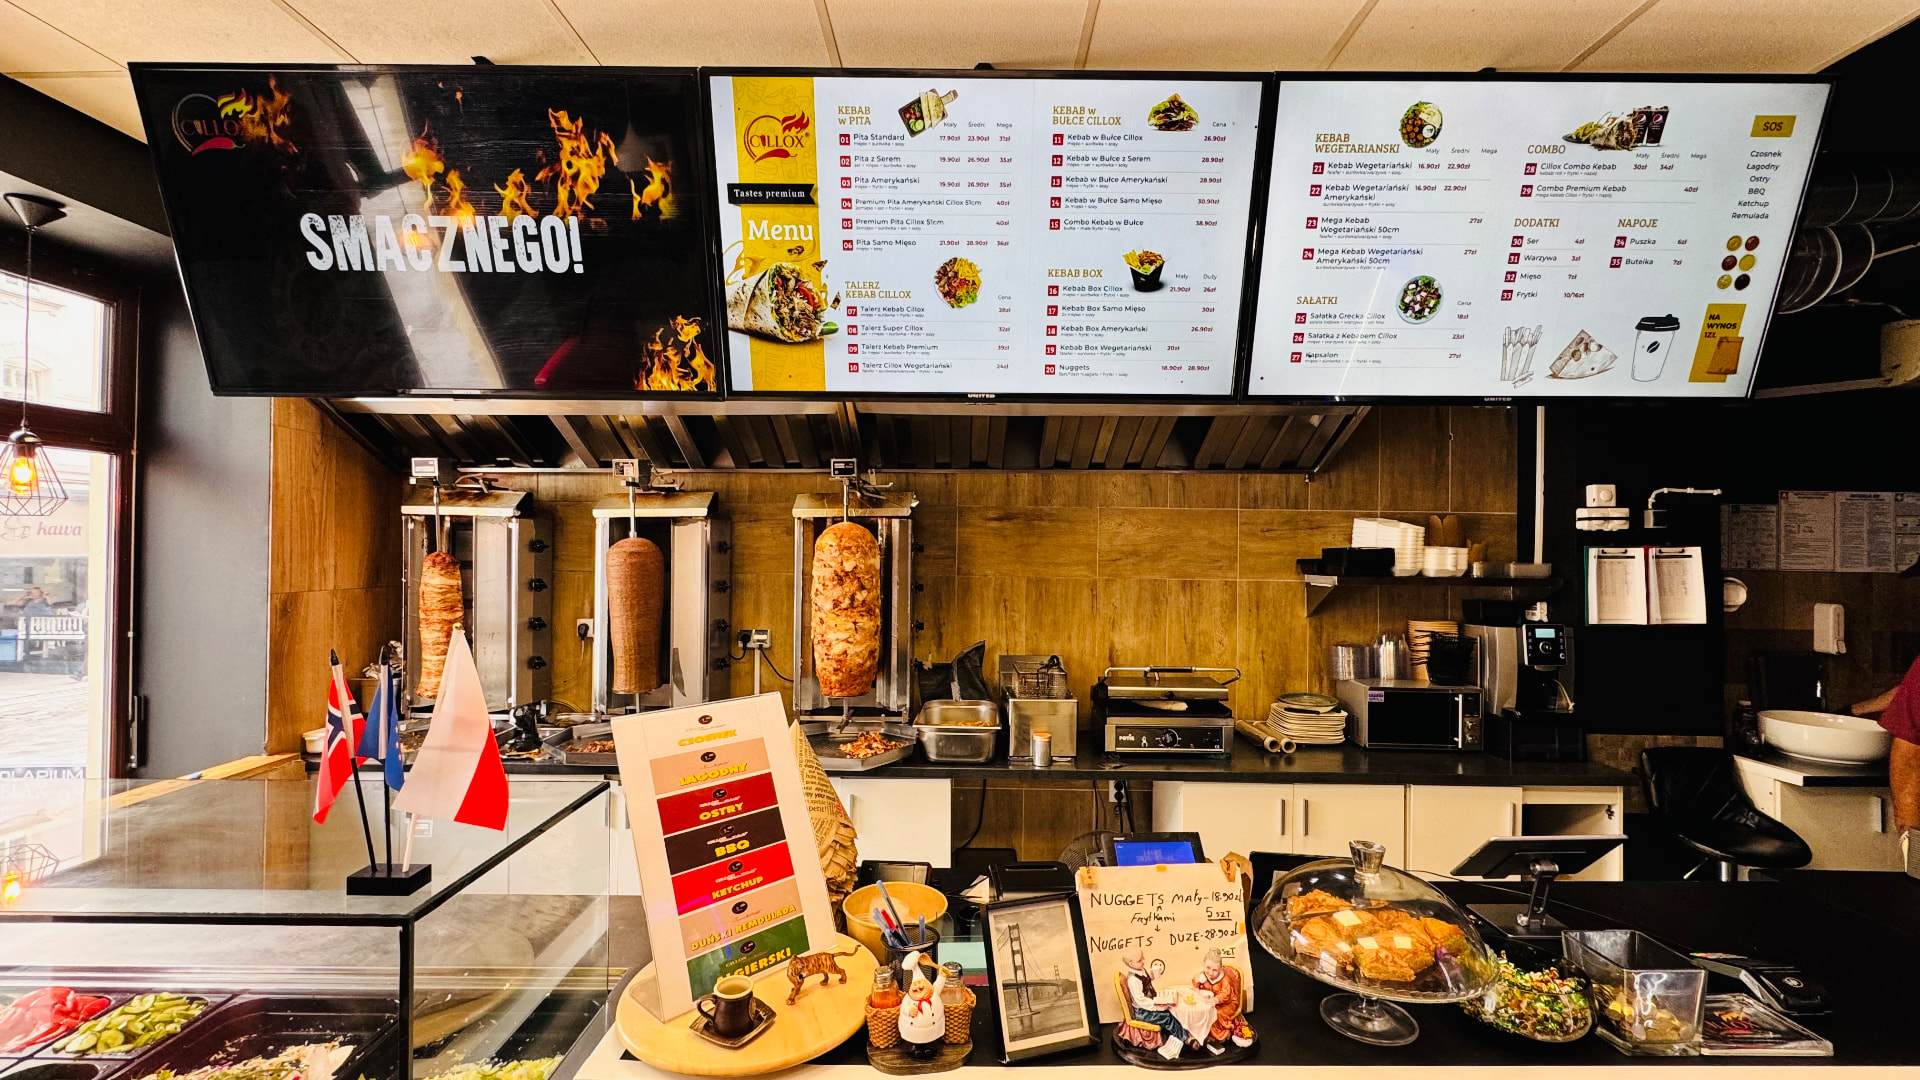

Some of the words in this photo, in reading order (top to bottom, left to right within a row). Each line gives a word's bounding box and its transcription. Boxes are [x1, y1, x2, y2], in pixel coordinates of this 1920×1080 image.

[837, 105, 870, 114] KEBAB
[1052, 105, 1085, 114] KEBAB
[849, 116, 871, 125] PITA
[1052, 116, 1084, 125] BUŁCE
[1086, 116, 1121, 125] CILLOX
[1762, 121, 1783, 131] SOS
[750, 134, 804, 149] CILLOX
[1315, 133, 1349, 142] KEBAB
[1314, 143, 1400, 153] WEGETARIANSKI
[1527, 144, 1565, 154] COMBO
[1354, 162, 1412, 171] Wegetariański
[1746, 163, 1779, 171] Łagodny
[870, 177, 919, 186] Amerykański
[1749, 175, 1770, 183] Ostry
[1352, 184, 1408, 192] Wegetariański
[734, 189, 762, 197] Tastes
[766, 190, 805, 198] premium
[901, 199, 944, 208] Amerykański
[1321, 216, 1342, 224] Mega
[1514, 218, 1559, 227] DODATKI
[1617, 218, 1658, 227] NAPOJE
[748, 220, 813, 240] Menu
[1319, 226, 1376, 235] Wegetariański
[299, 212, 584, 274] SMACZNEGO!
[1316, 257, 1366, 266] Amerykański
[1048, 269, 1080, 277] KEBAB
[1082, 269, 1102, 277] BOX
[844, 281, 880, 289] TALERZ
[845, 290, 876, 298] KEBAB
[1296, 296, 1337, 304] SAŁATKI
[1338, 312, 1363, 321] Grecka
[882, 325, 903, 333] Super
[1100, 325, 1147, 334] Amerykański
[1100, 345, 1151, 354] Wegetariański
[1305, 352, 1338, 360] Kapsalon
[902, 362, 952, 371] Wegetariański
[1059, 364, 1089, 373] Nuggets
[36, 521, 83, 536] kawa
[699, 802, 743, 821] OSTRY
[714, 839, 750, 858] BBQ
[712, 876, 764, 900] KETCHUP
[1090, 893, 1164, 908] NUGGETS
[1206, 907, 1213, 918] 5
